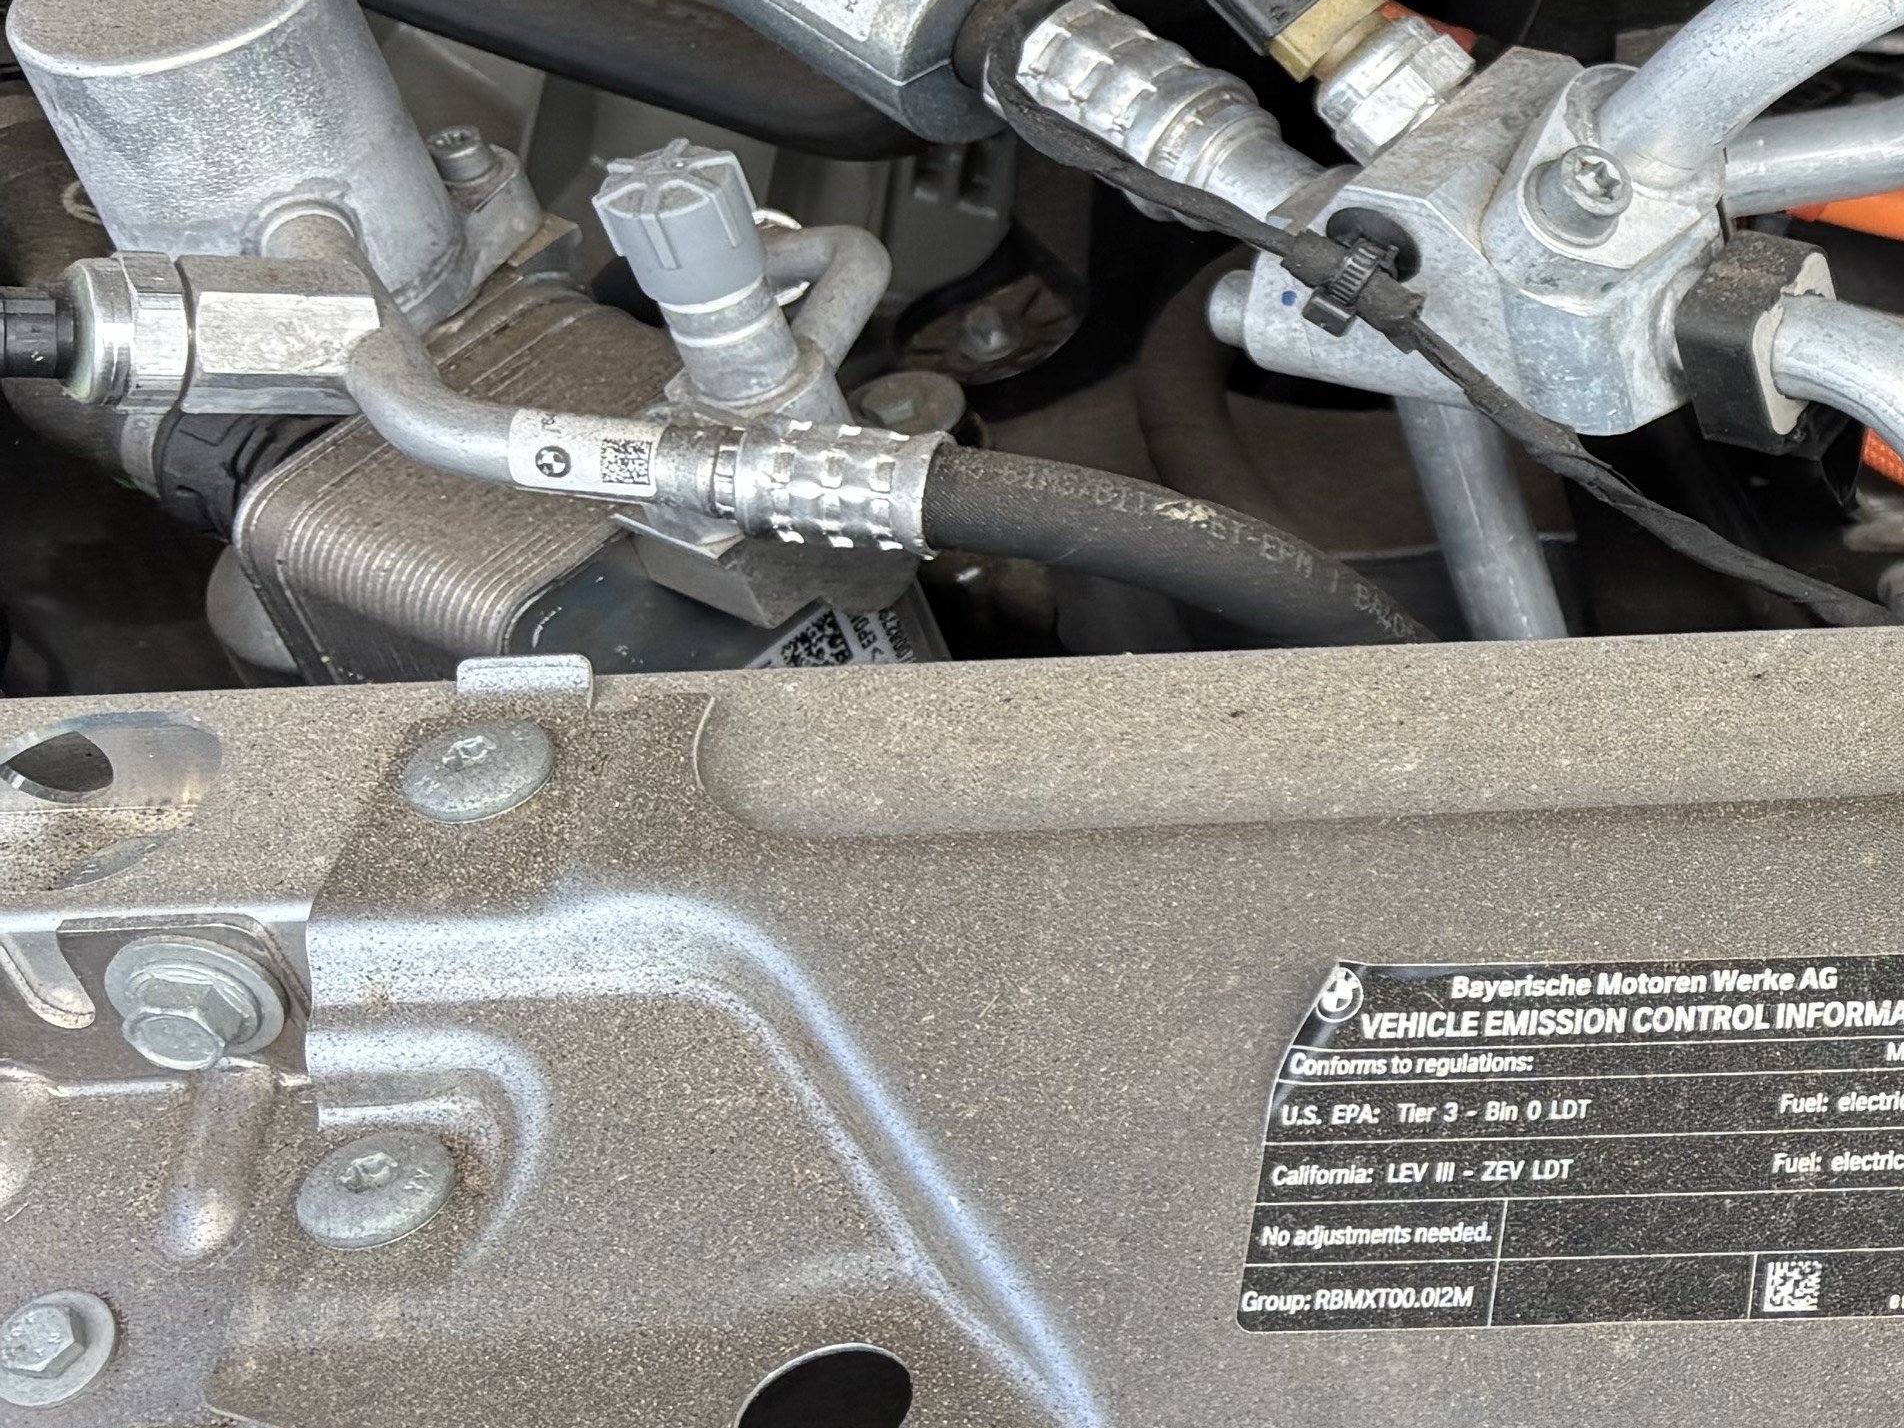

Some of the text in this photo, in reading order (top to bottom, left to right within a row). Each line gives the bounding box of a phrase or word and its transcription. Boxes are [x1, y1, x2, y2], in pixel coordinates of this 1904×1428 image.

[1450, 966, 1839, 1003] Bayerische Motoren Werke AG
[1361, 1010, 1480, 1040] VEHICLE
[1484, 1007, 1628, 1039] EMISSION
[1632, 1002, 1771, 1035] CONTROL
[1288, 1050, 1535, 1078] Conforms to regulations:
[1281, 1103, 1323, 1126] U.S.
[1331, 1104, 1382, 1126] EPA:
[1397, 1102, 1435, 1124] Tier
[1443, 1101, 1459, 1122] 3
[1484, 1099, 1518, 1122] Bin
[1527, 1099, 1542, 1121] 0
[1550, 1098, 1592, 1121] LDT
[1778, 1091, 1829, 1115] Fuel:
[1270, 1164, 1374, 1187] California:
[1386, 1161, 1430, 1185] LEV
[1436, 1162, 1455, 1183] III
[1480, 1160, 1525, 1182] ZEV
[1531, 1159, 1575, 1181] LDT
[1772, 1151, 1823, 1174] Fuel:
[1260, 1220, 1493, 1250] No adjustments needed.
[1240, 1289, 1311, 1316] Group:
